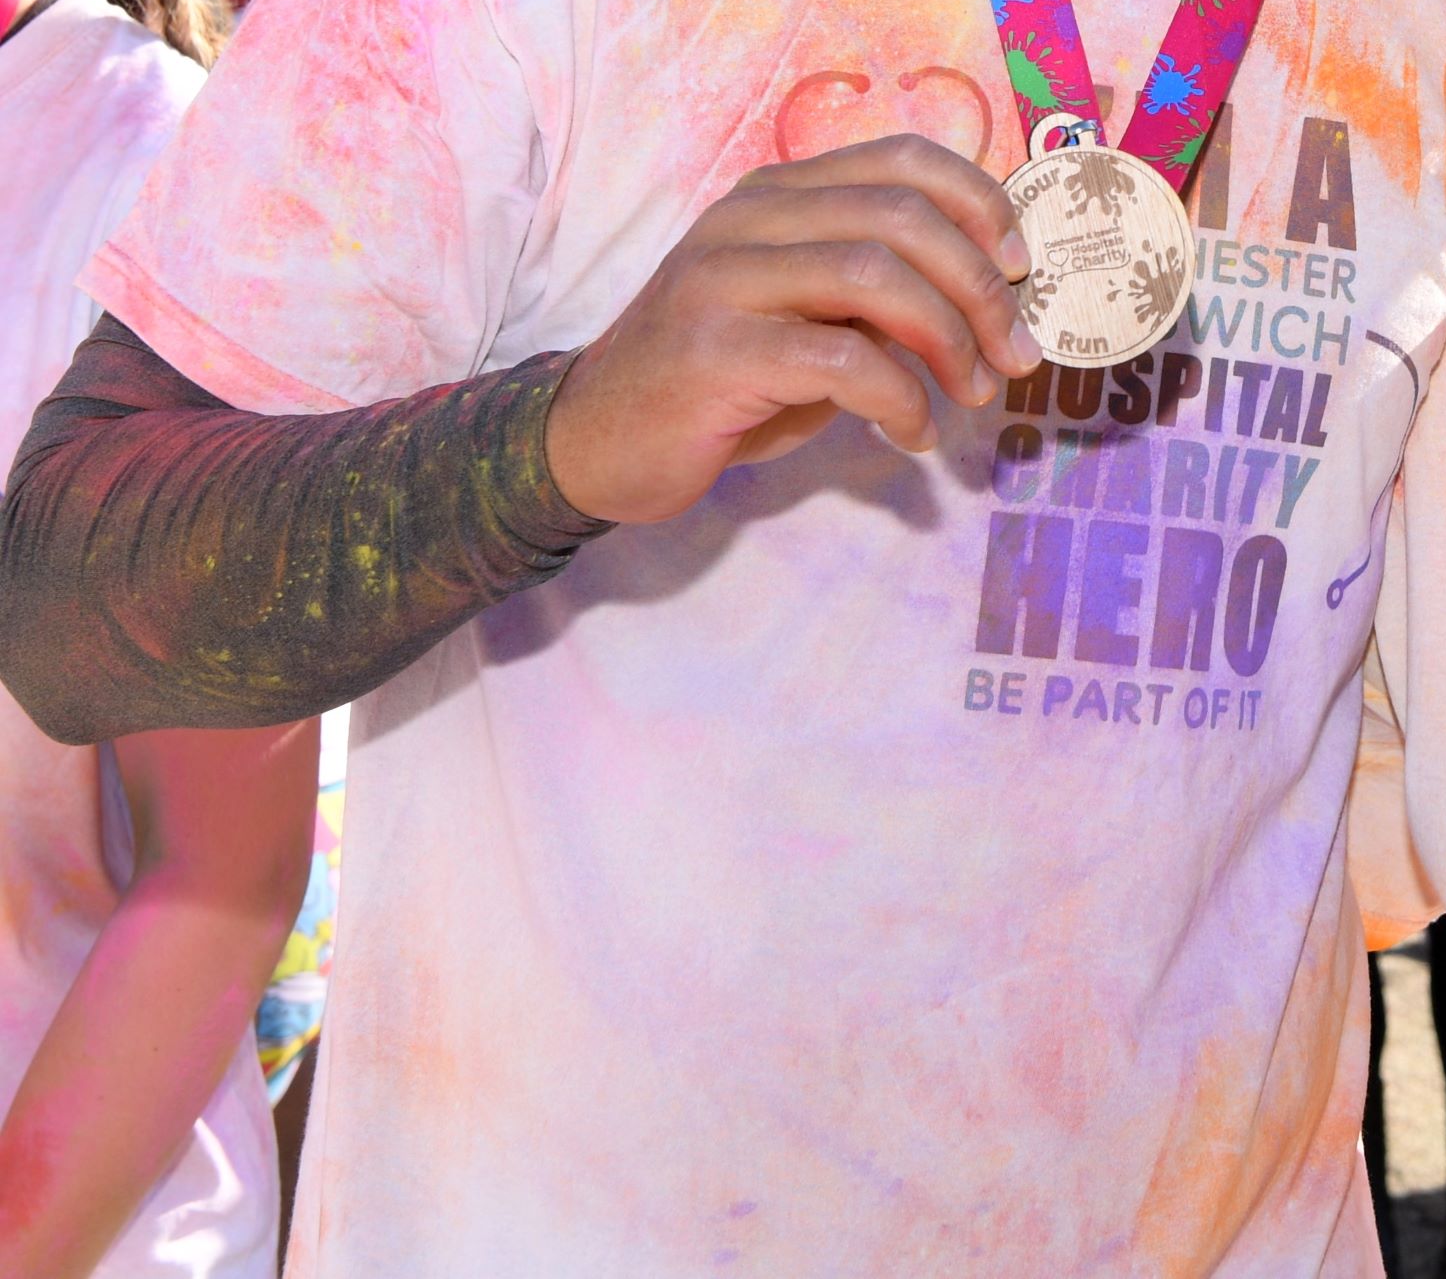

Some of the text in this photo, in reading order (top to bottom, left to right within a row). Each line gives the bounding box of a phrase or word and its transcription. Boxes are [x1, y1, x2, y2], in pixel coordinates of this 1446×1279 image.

[1285, 116, 1357, 251] A
[1070, 234, 1125, 256] Hospitals
[1071, 248, 1127, 270] Charity
[1057, 329, 1110, 354] Run
[992, 423, 1321, 530] CHARITY
[975, 510, 1288, 678] HERO
[963, 669, 1262, 731] BE PART OF IT
